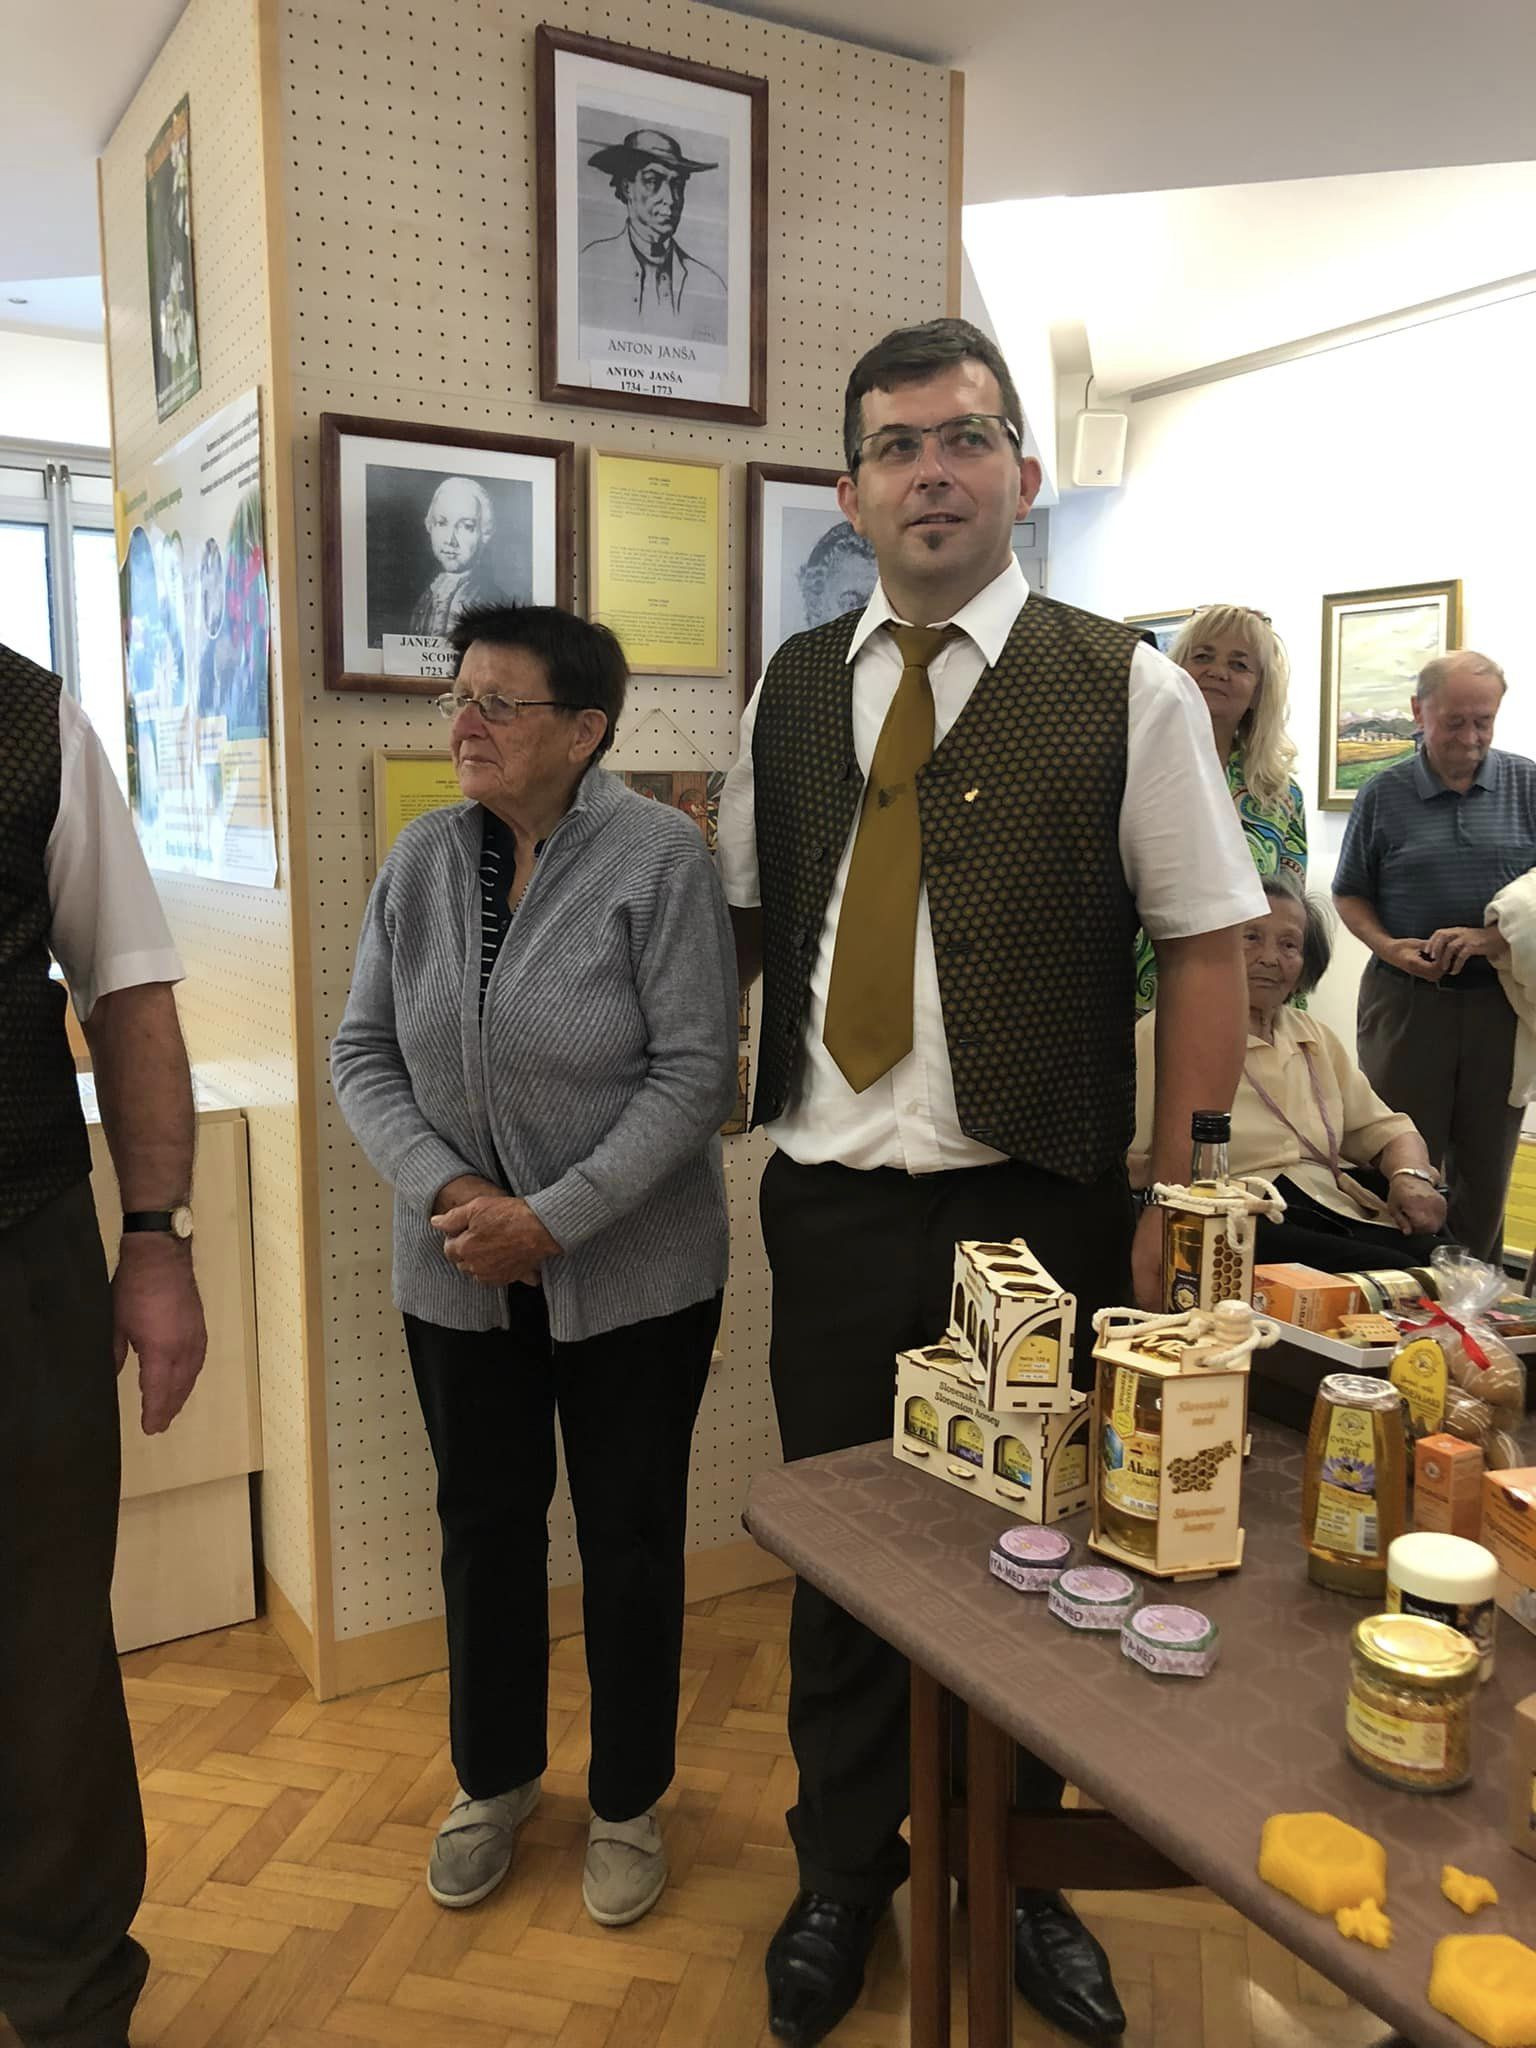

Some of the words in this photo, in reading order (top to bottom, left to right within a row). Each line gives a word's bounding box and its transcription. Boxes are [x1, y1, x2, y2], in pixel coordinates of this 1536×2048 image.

[608, 339, 653, 355] ANTON
[657, 345, 697, 361] JANŠA
[606, 367, 645, 379] ANTON
[648, 370, 684, 384] JANŠA
[620, 381, 641, 392] 1734
[651, 383, 673, 395] 1773
[400, 636, 440, 648] JANEZ
[421, 652, 457, 663] SCOP
[420, 666, 443, 677] 1723
[934, 1391, 974, 1415] Slovenian
[975, 1408, 1000, 1428] honey
